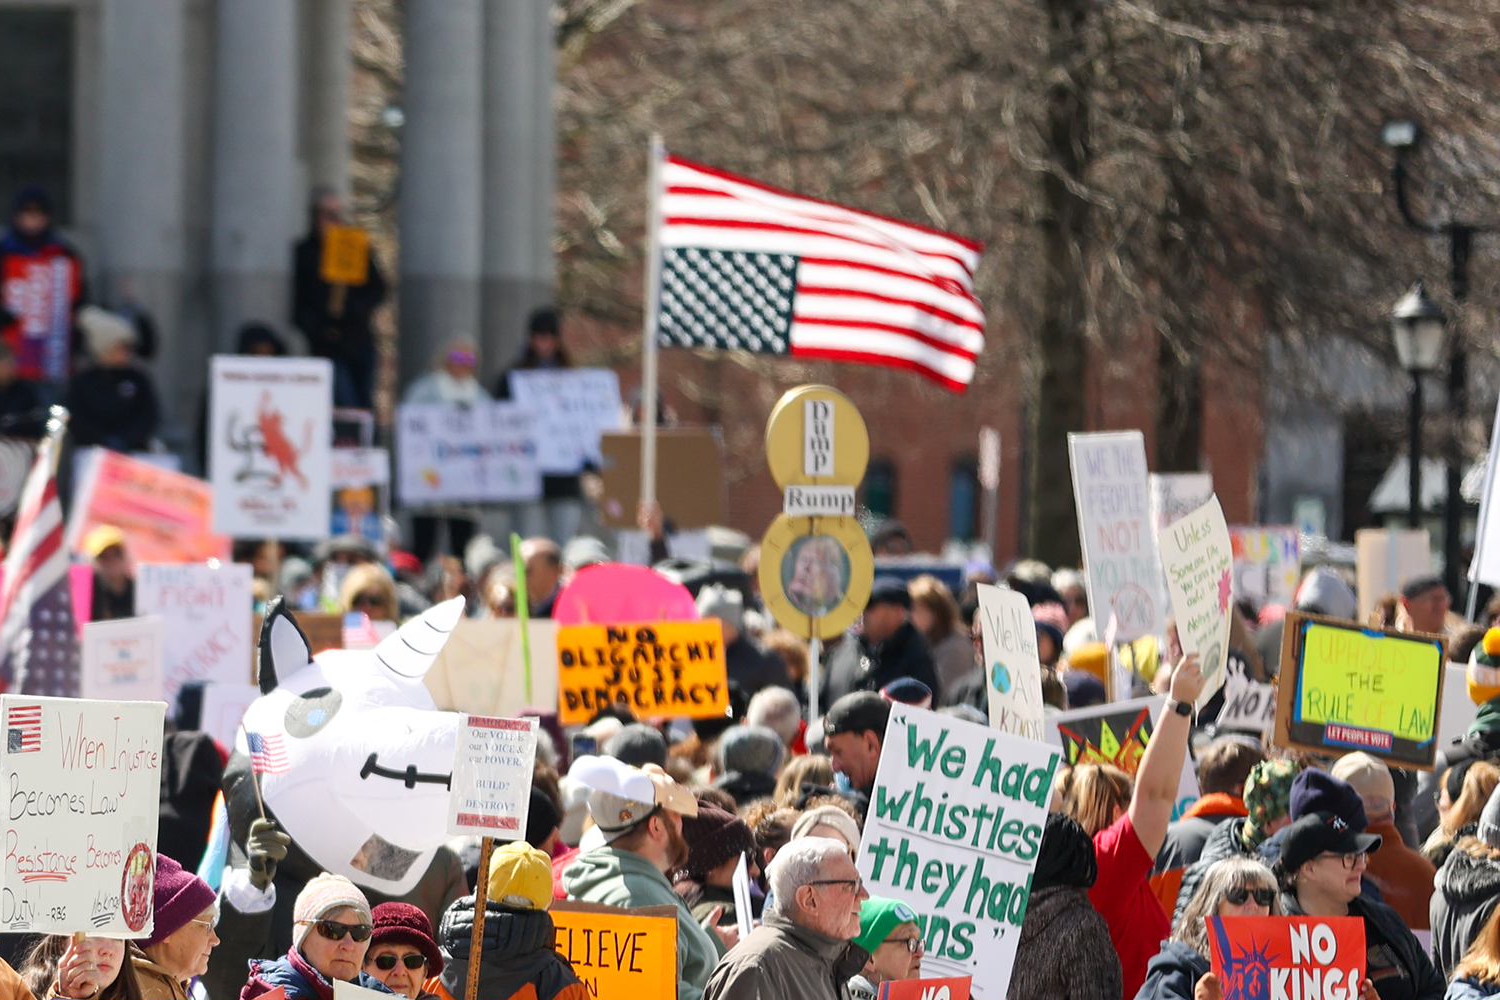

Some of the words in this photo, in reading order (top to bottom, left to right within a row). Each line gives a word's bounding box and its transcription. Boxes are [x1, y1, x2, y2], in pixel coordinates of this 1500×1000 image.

[811, 401, 830, 472] Dump
[1085, 450, 1111, 477] WE
[788, 488, 853, 513] Rump
[1086, 483, 1142, 515] PEOPLE
[1097, 520, 1141, 555] NOT
[1174, 519, 1212, 553] Unless
[606, 627, 657, 644] NO
[985, 604, 1014, 653] We
[561, 641, 716, 667] OLIGARCHY
[1318, 631, 1407, 675] UPHOLD
[564, 683, 720, 711] DEMOCRACY
[1346, 671, 1384, 692] THE
[1227, 692, 1260, 718] NO
[1307, 687, 1356, 724] RULE
[1363, 701, 1395, 726] OF
[1398, 703, 1434, 736] LAW
[467, 716, 531, 731] DEMOCRACY
[472, 729, 488, 739] Our
[489, 730, 516, 741] VOTE
[1327, 724, 1341, 741] LET
[1342, 727, 1370, 744] PEOPLE
[1371, 732, 1392, 748] VOTE
[57, 711, 107, 772] When
[469, 742, 483, 751] our
[485, 742, 515, 753] VOICE
[476, 780, 510, 790] BUILD?
[971, 738, 1060, 809] had
[9, 772, 86, 821] Becomes
[90, 779, 119, 815] Law
[466, 799, 515, 812] DESTROY?
[875, 781, 1043, 861] whistles
[5, 829, 78, 876] Resistance
[86, 833, 122, 869] Becomes
[867, 836, 968, 909] they
[962, 857, 1035, 927] had
[2, 886, 42, 925] Duty!
[554, 925, 647, 973] ELIEVE
[1288, 923, 1338, 967] NO
